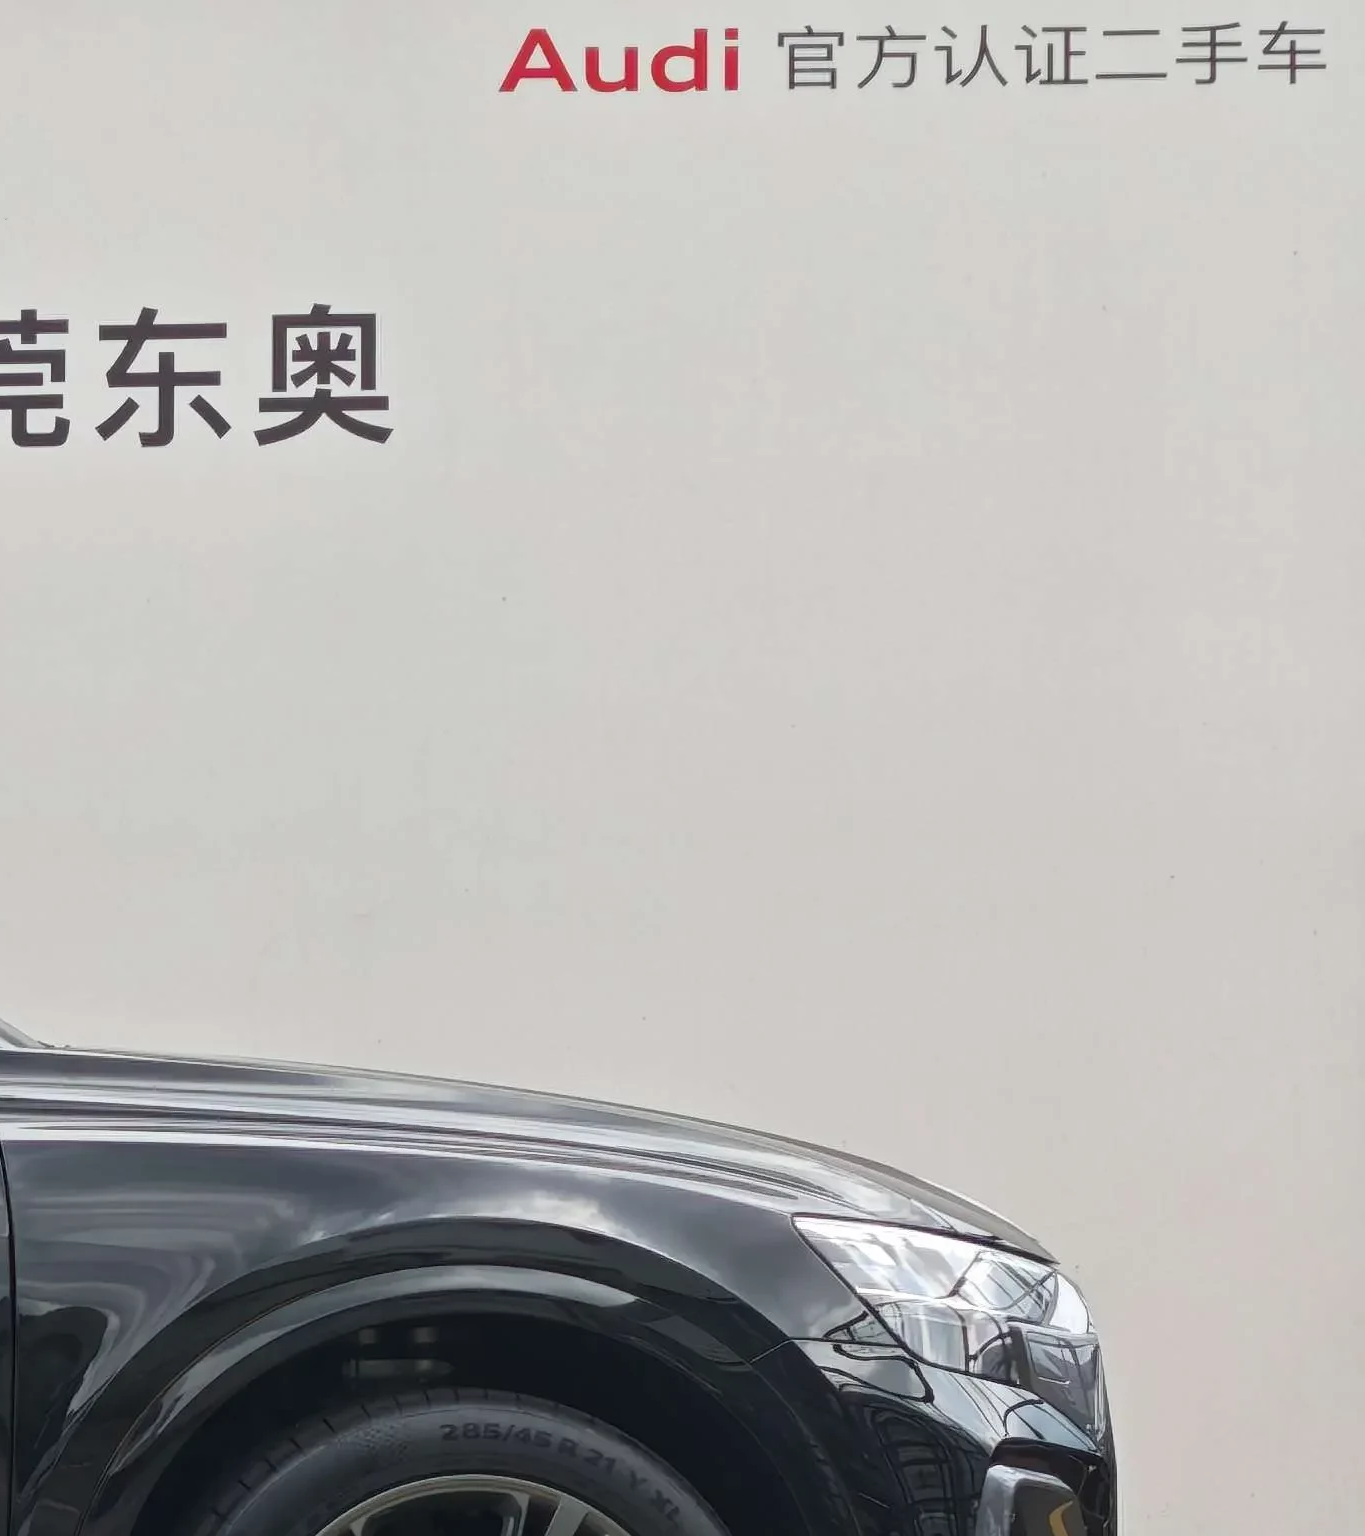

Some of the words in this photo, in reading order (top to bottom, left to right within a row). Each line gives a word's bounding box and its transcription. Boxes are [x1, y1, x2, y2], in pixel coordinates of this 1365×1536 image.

[501, 27, 739, 93] Audi
[777, 20, 1327, 90] 官方认证二手车
[439, 1422, 551, 1449] 285/45
